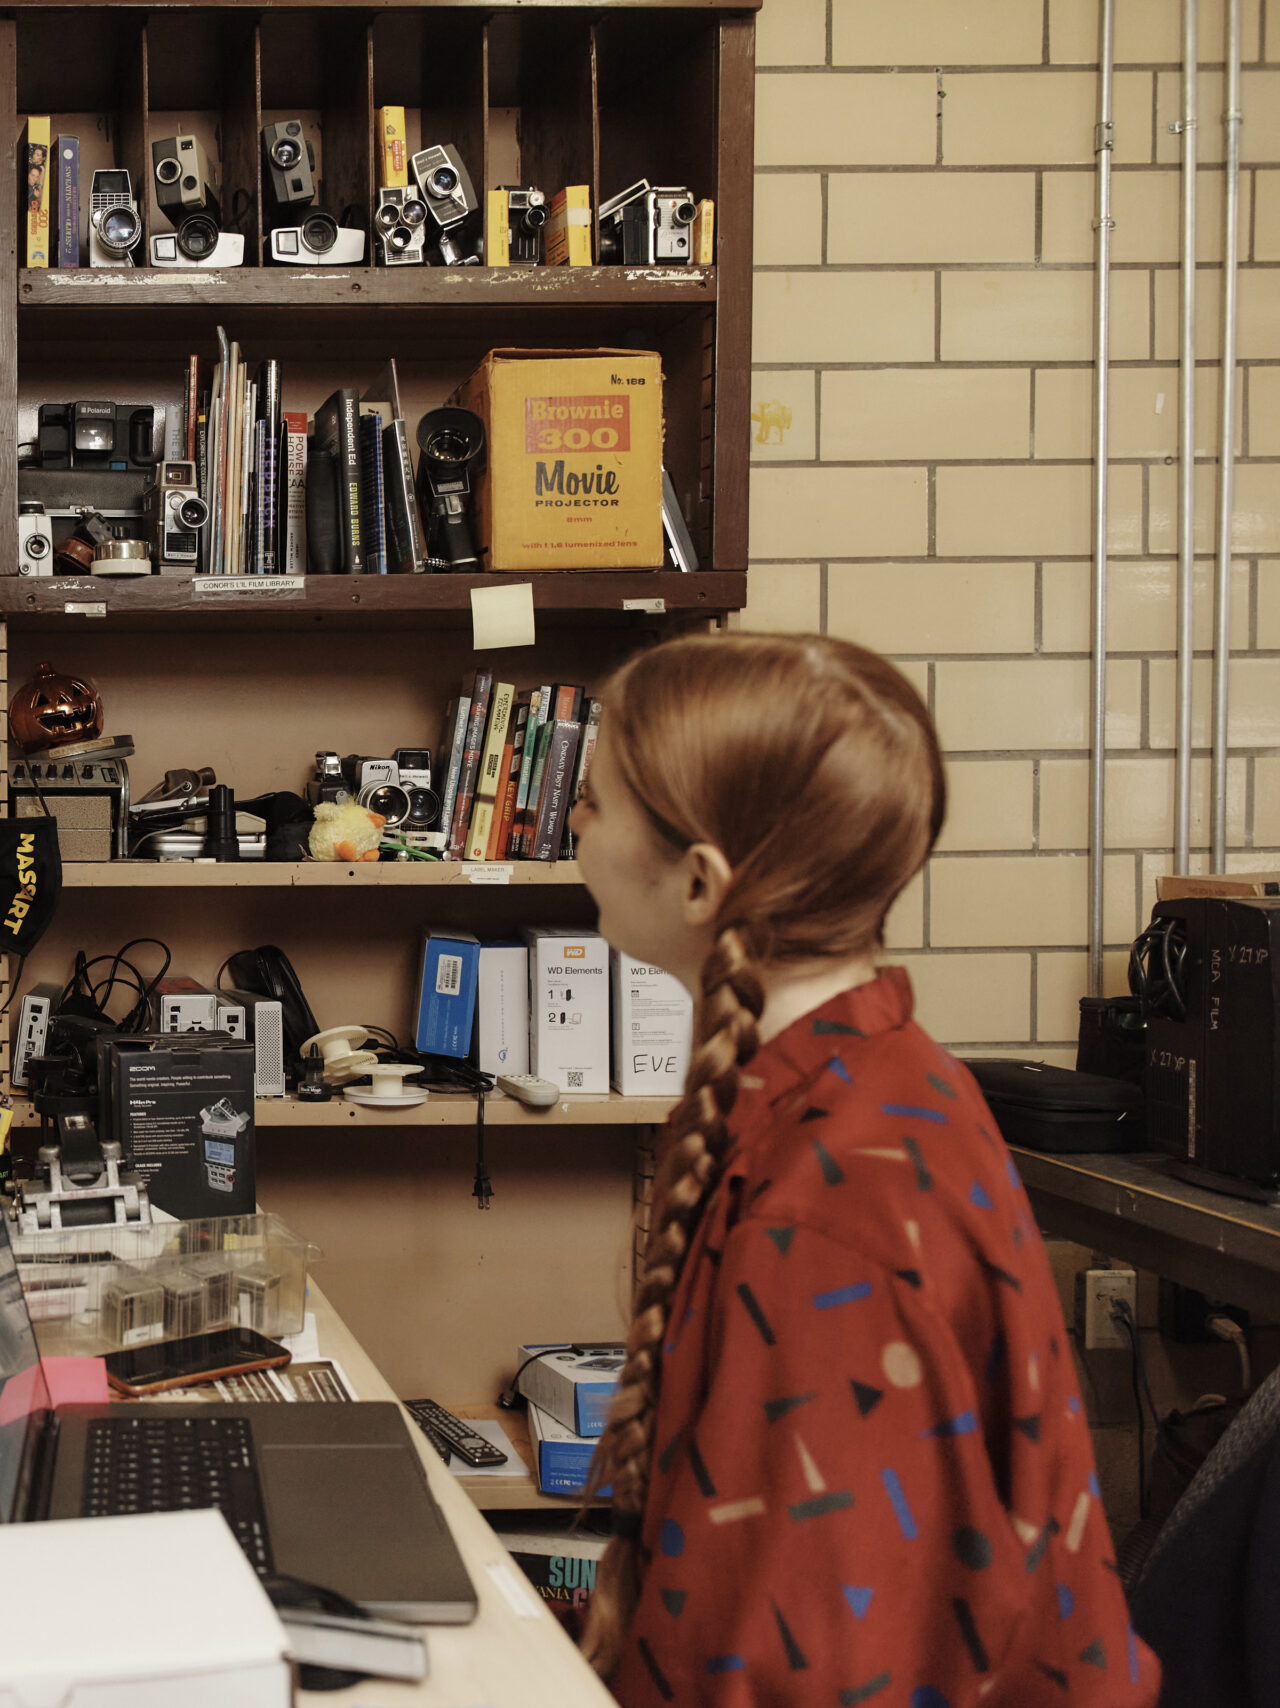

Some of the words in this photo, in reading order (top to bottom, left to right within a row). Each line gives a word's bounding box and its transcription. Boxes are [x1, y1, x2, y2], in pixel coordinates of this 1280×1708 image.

[610, 374, 624, 385] No.
[86, 407, 111, 415] Polaroid
[532, 400, 624, 421] Brownie
[346, 398, 356, 450] Independent
[538, 427, 619, 450] 300
[295, 436, 304, 476] POWER
[348, 452, 357, 466] Ed
[263, 436, 278, 528] FEEDBACK
[535, 460, 620, 496] Movie
[349, 482, 359, 516] EDWARD
[535, 499, 619, 507] PROJECTOR
[351, 518, 361, 547] BURNS
[564, 540, 616, 549] lumenized
[617, 540, 638, 548] lens
[202, 582, 234, 590] CONOR'S
[458, 706, 466, 727] Luther
[475, 702, 483, 726] MAKING
[499, 693, 510, 733] EXPERIMENTAL
[471, 728, 480, 751] IMAGES
[558, 740, 568, 770] CINEMA'S
[448, 777, 456, 796] Utopia
[507, 781, 515, 798] KEY
[556, 771, 565, 788] FIRST
[553, 788, 562, 810] NASTY
[548, 810, 558, 836] WOMEN
[4, 833, 37, 936] MASSART
[566, 948, 584, 956] WD
[547, 966, 563, 975] WD
[564, 966, 603, 975] Elements
[630, 967, 646, 976] WD
[548, 989, 554, 1000] 1
[548, 1012, 556, 1023] 2
[1210, 997, 1220, 1031] FILM
[632, 1054, 678, 1074] EVE
